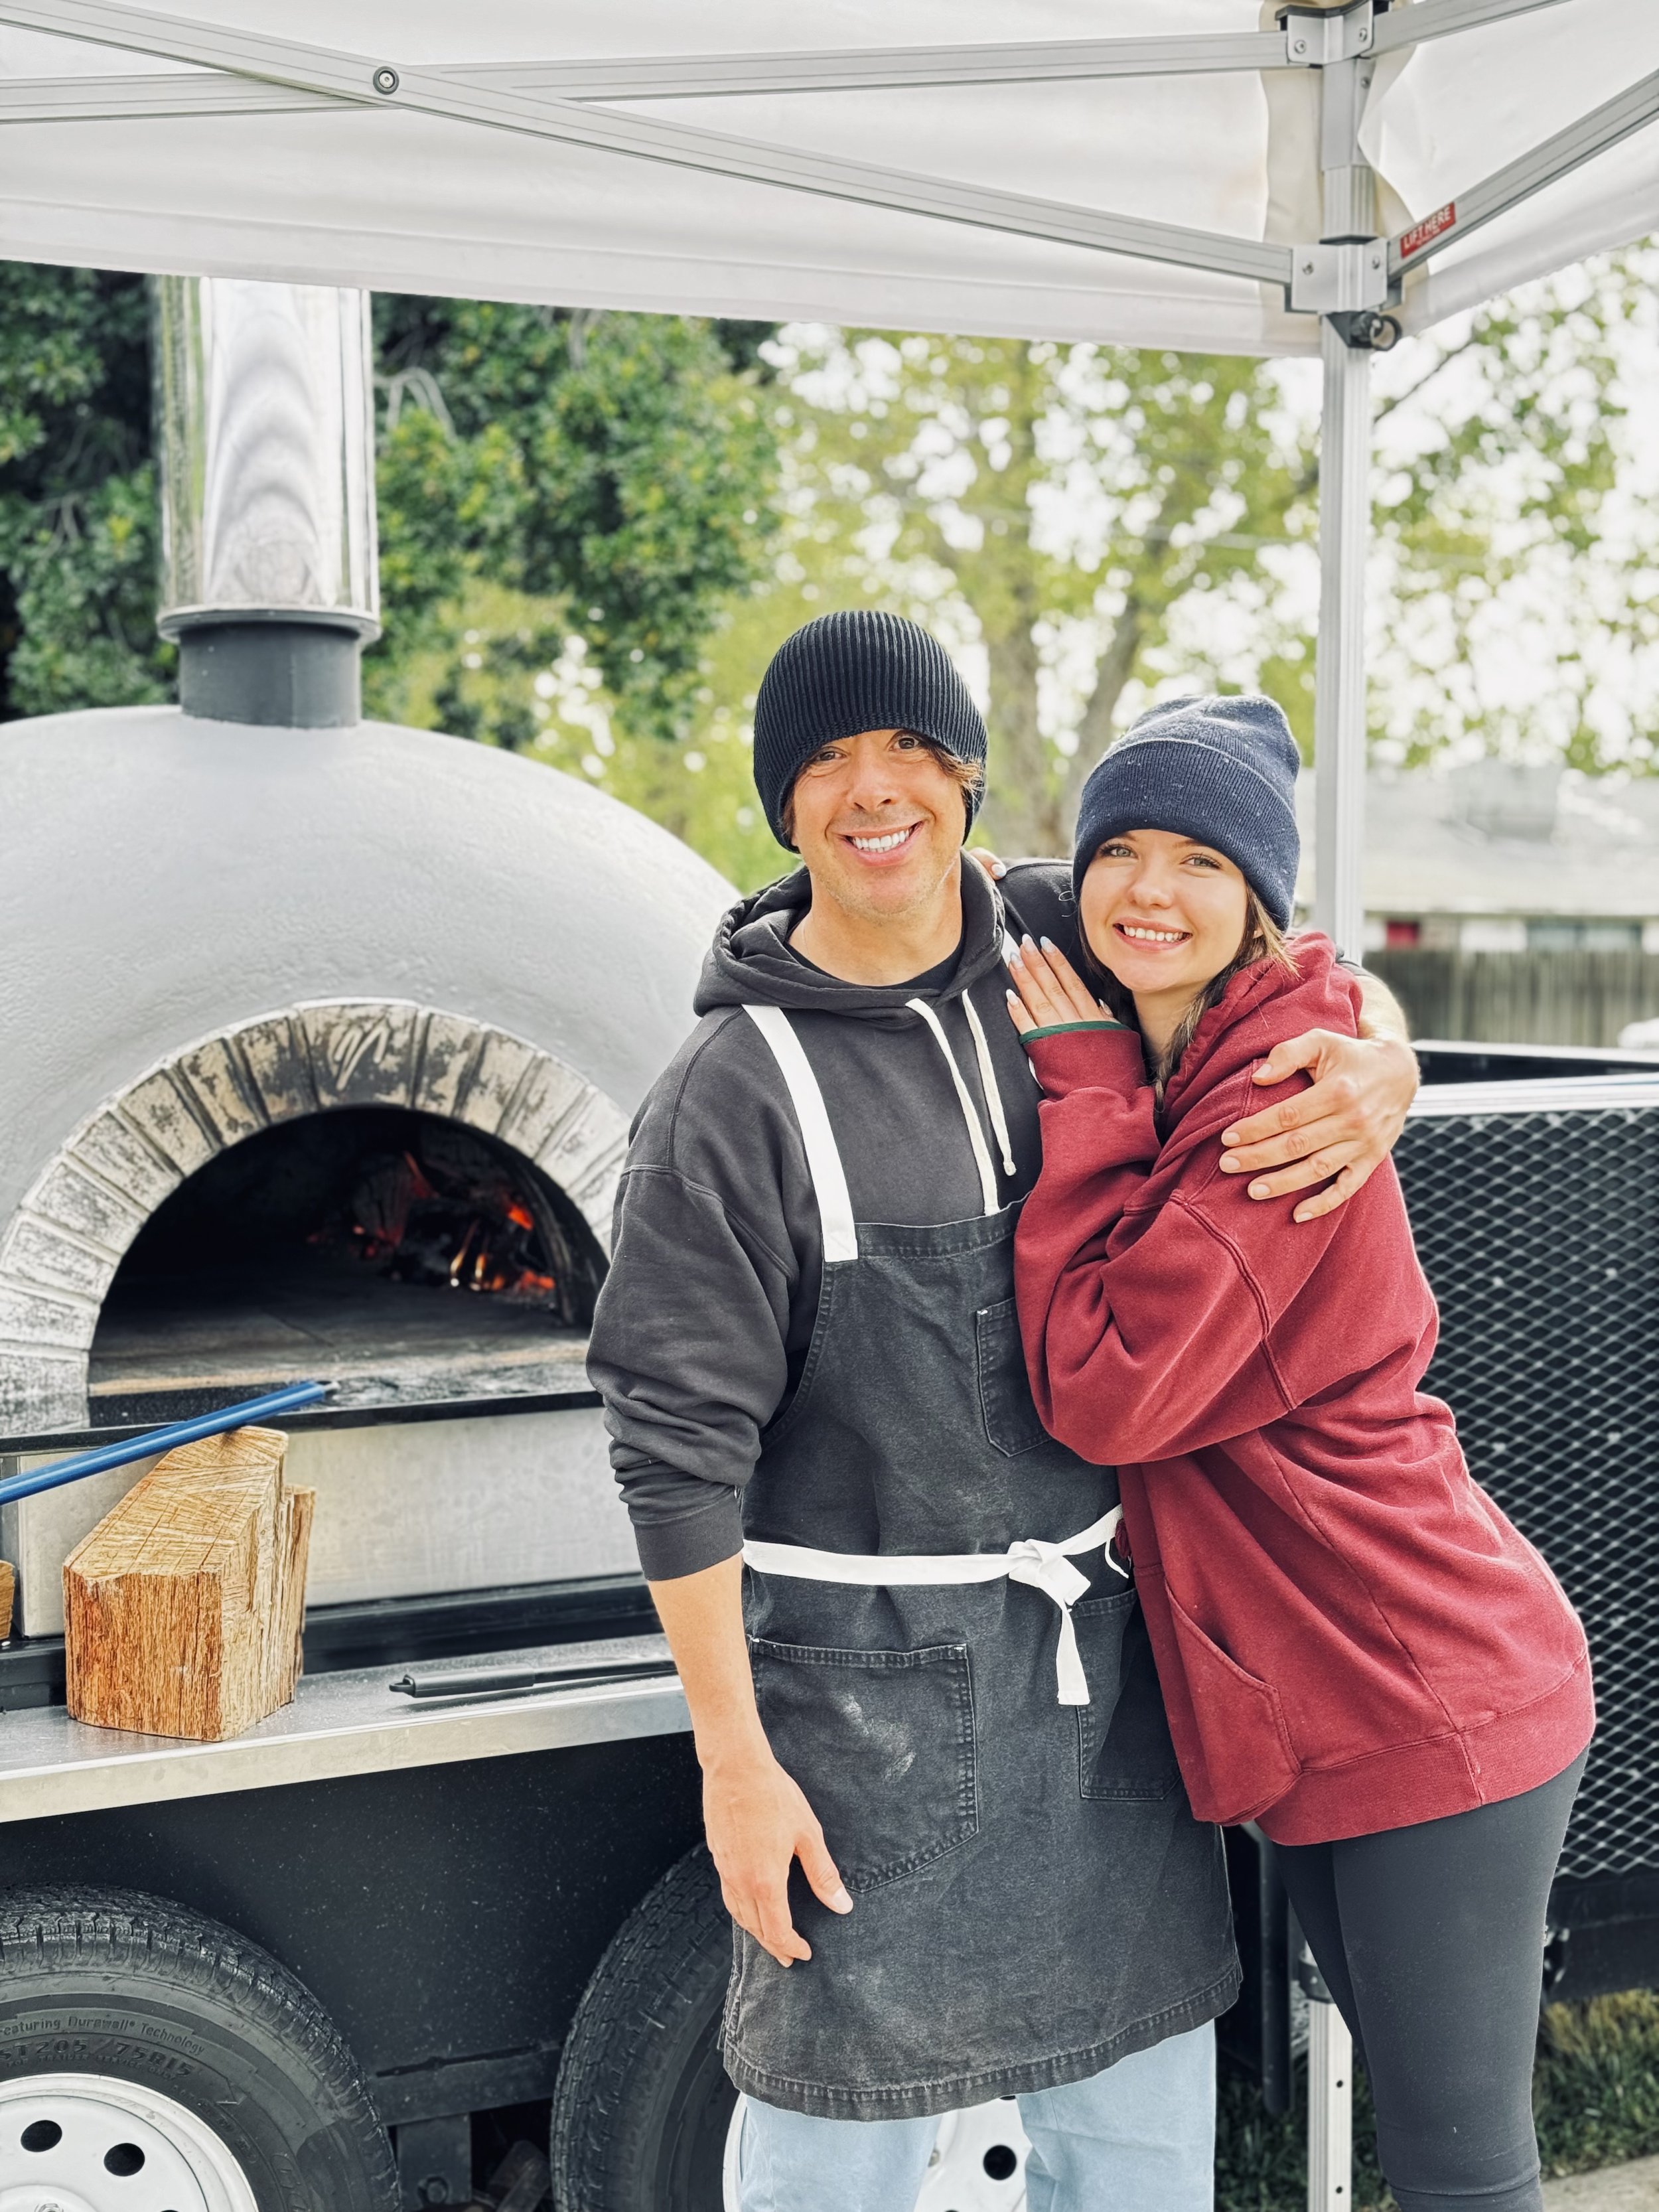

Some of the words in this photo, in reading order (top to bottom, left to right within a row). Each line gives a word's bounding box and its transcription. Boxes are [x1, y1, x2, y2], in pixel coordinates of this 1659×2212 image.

[1403, 225, 1423, 250] LIFT
[1424, 205, 1451, 234] HERE
[0, 2019, 60, 2036] eaturing
[140, 2022, 205, 2056] Technology
